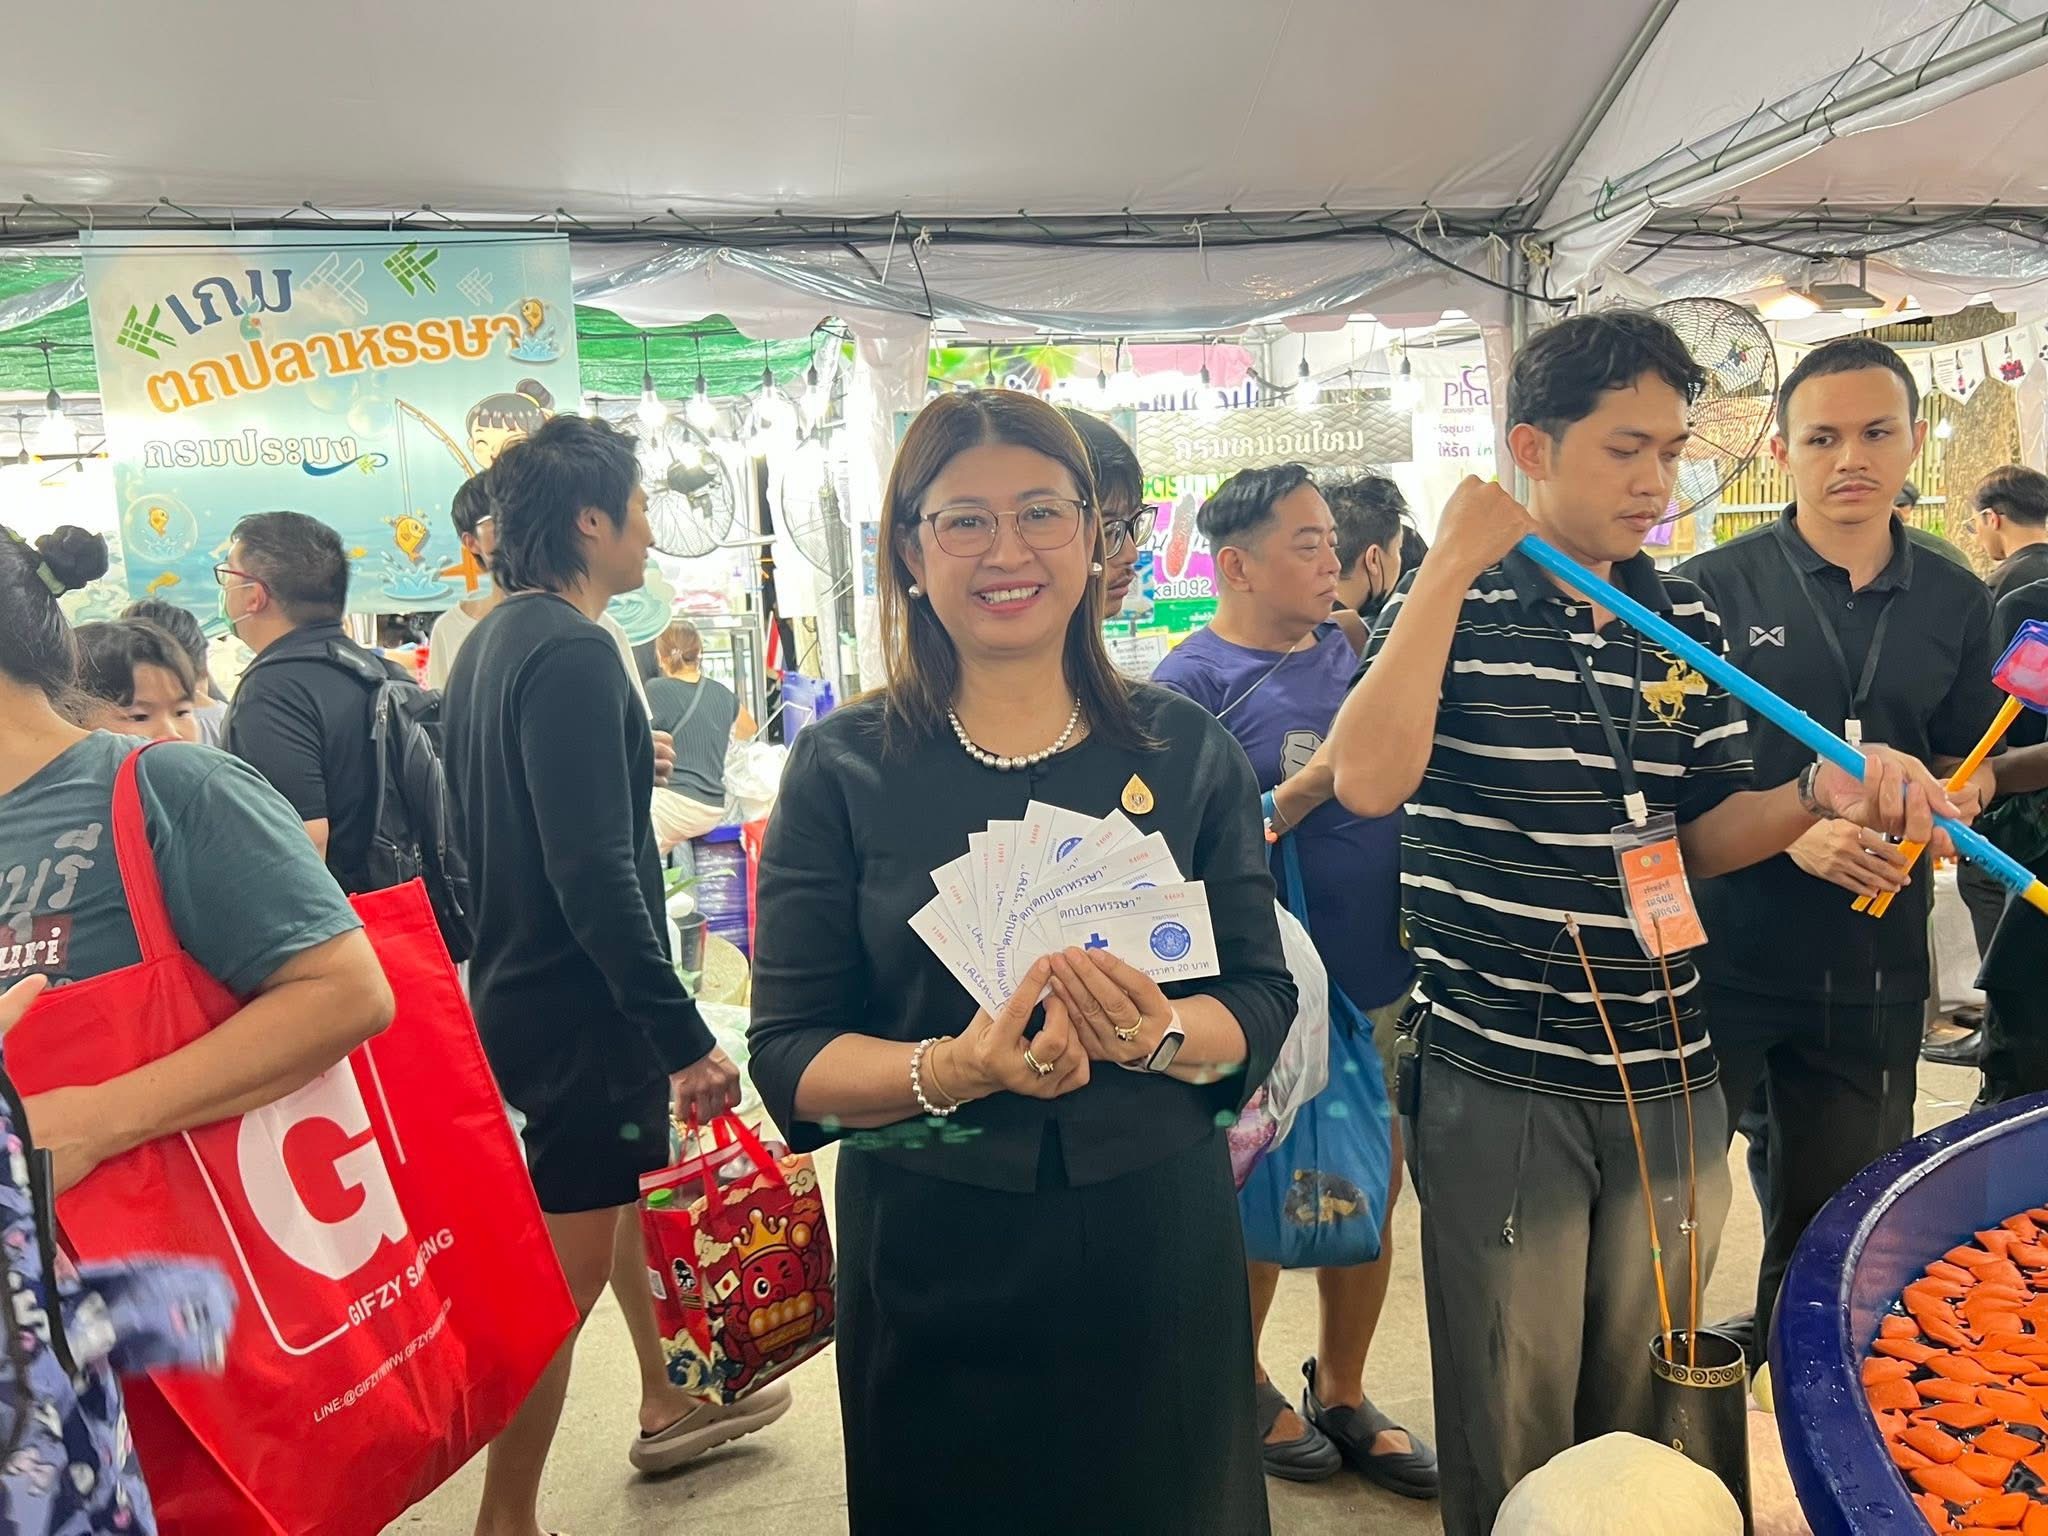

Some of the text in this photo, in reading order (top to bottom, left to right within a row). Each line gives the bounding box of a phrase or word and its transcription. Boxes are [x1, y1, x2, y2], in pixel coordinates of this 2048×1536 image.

[165, 268, 293, 336] เกม
[145, 315, 520, 414] ตกปลาหรรษา
[144, 428, 358, 469] กรมประมง
[1174, 421, 1365, 463] กรมหม่อนไหม
[1177, 962, 1190, 974] 20
[1191, 960, 1210, 972] บาท
[237, 1055, 408, 1281] G
[347, 1275, 404, 1328] GIFZY
